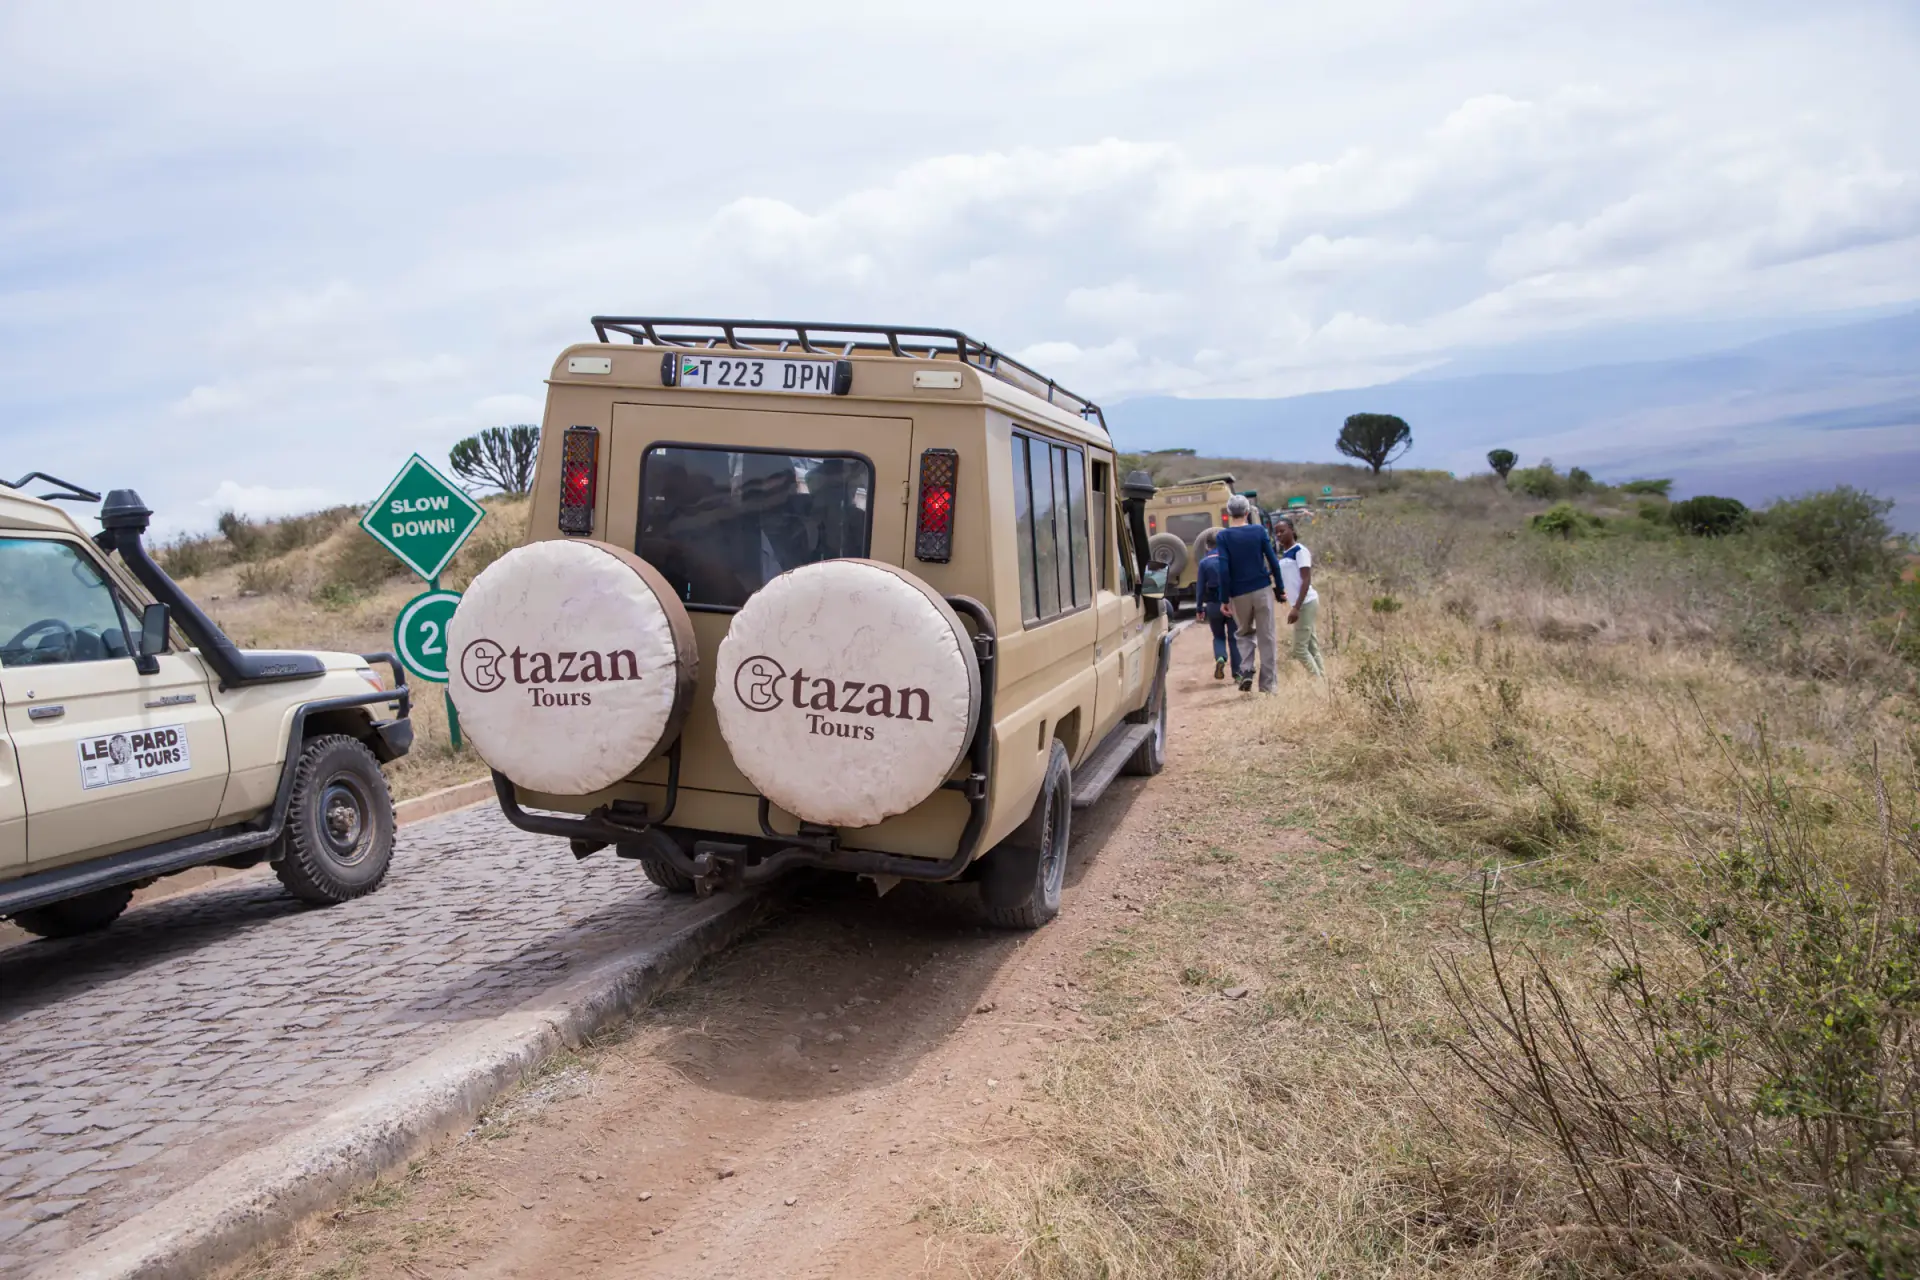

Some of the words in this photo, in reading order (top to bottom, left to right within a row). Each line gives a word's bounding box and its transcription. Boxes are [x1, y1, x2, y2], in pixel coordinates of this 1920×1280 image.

[700, 360, 712, 385] T
[718, 361, 764, 387] 223
[783, 363, 830, 391] DPN
[390, 496, 450, 514] SLOW
[391, 518, 455, 538] DOWN!
[419, 618, 450, 656] 2
[509, 645, 642, 684] tazan
[527, 687, 591, 707] Tours
[790, 667, 933, 722] tazan
[805, 713, 875, 741] Tours
[134, 747, 181, 769] TOURS
